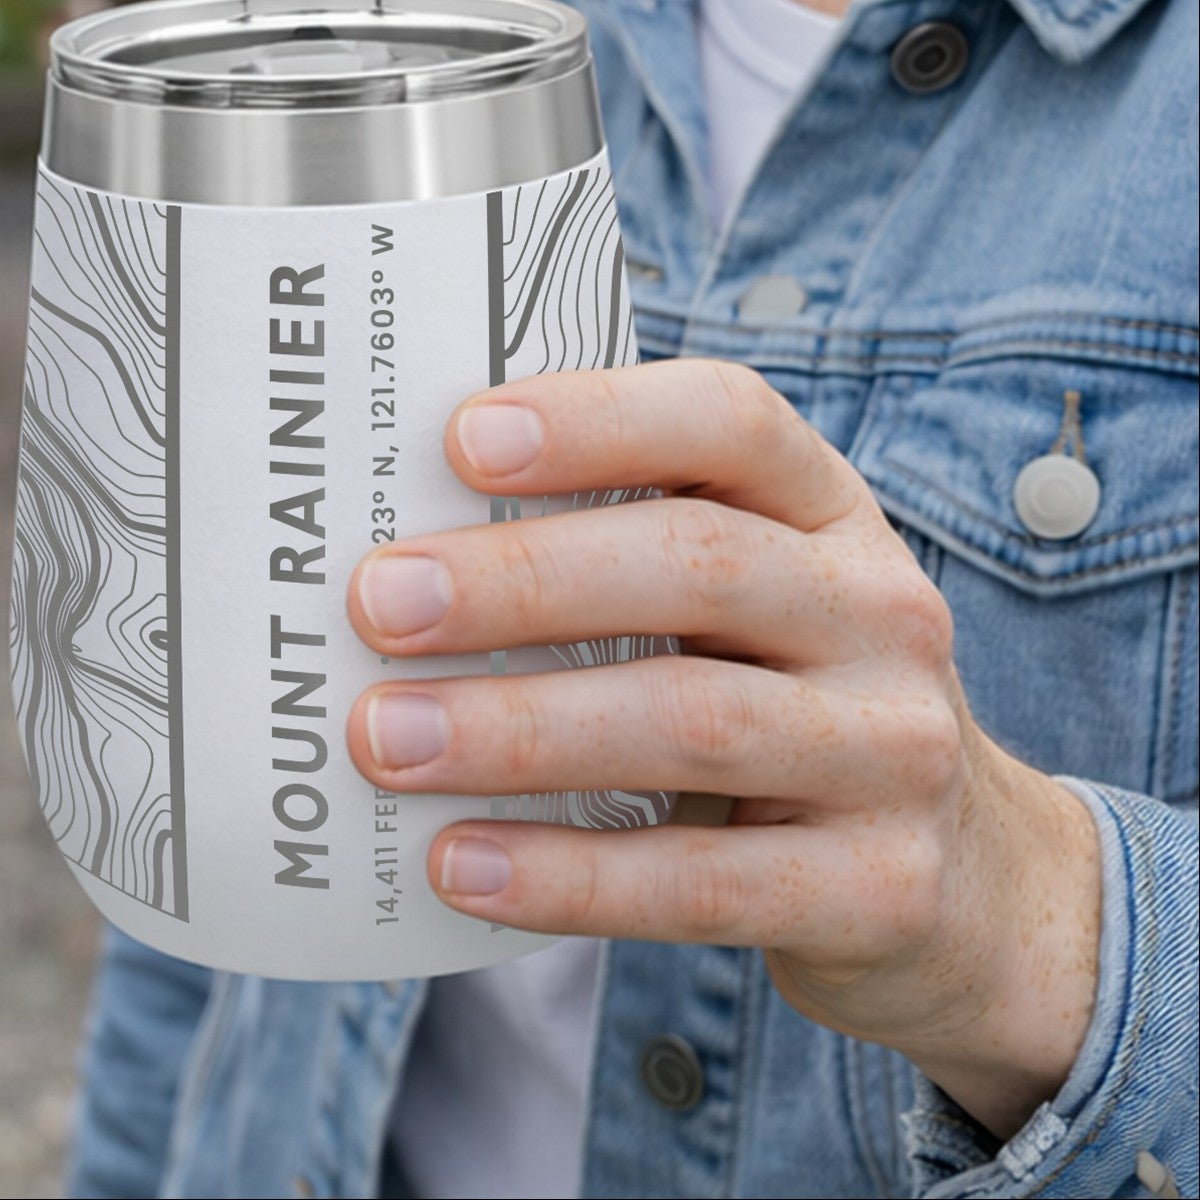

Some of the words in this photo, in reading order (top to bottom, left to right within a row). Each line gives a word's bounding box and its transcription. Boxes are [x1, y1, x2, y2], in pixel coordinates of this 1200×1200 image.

[370, 223, 395, 256] W
[269, 263, 326, 585] RAINIER
[371, 445, 400, 477] N,
[270, 614, 331, 890] MOUNT
[374, 787, 398, 833] FEE
[374, 846, 402, 926] 14,411
